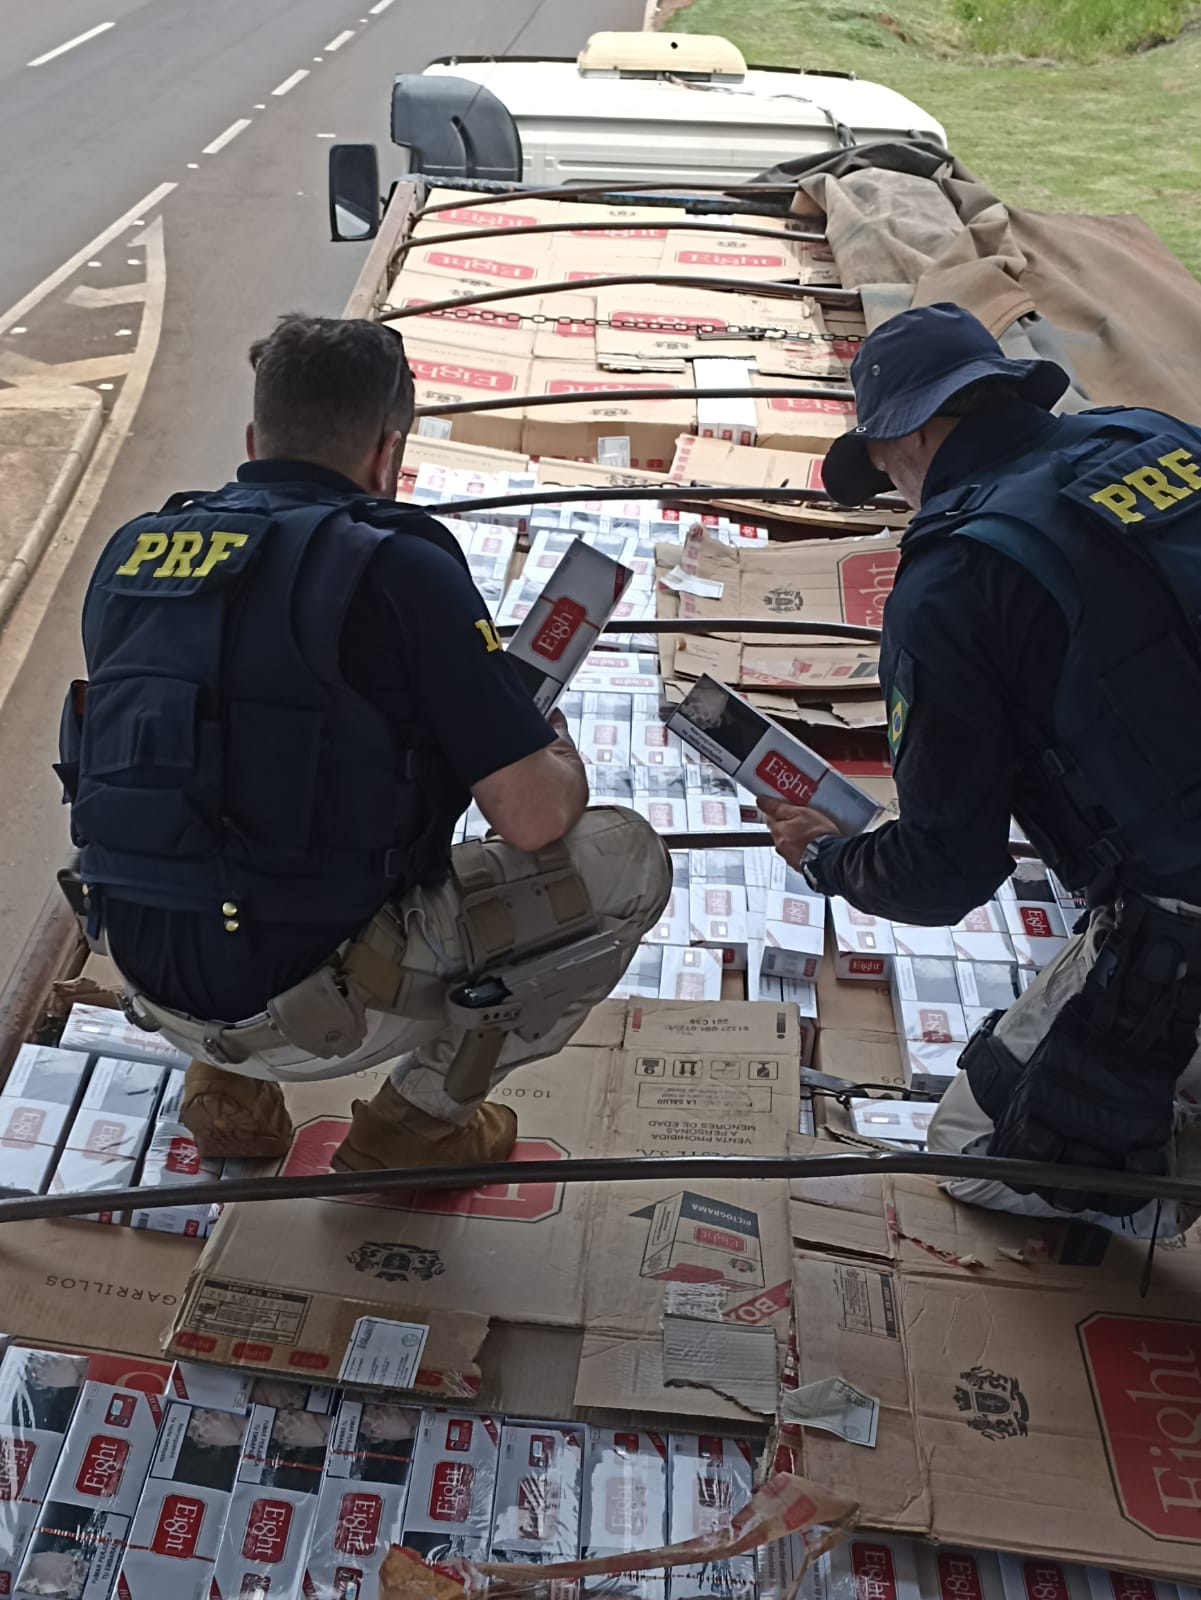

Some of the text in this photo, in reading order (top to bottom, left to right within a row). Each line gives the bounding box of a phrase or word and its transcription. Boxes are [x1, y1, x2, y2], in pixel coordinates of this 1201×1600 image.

[1089, 448, 1201, 524] PRF
[116, 531, 249, 577] PRF
[766, 757, 816, 799] Eight
[1026, 910, 1046, 934] Eight
[853, 960, 881, 973] Eight
[924, 1013, 946, 1040] Eight
[648, 1120, 757, 1131] MENORES DE EDAD
[651, 1133, 752, 1145] VENTA PROHIBIDA
[666, 1128, 728, 1137] PERSONAS
[691, 1203, 753, 1226] PICTOGRAMA
[45, 1275, 177, 1307] GARRILLOS
[260, 1419, 269, 1437] FUMAR
[83, 1440, 120, 1489] Eight
[437, 1466, 468, 1516] Eight
[164, 1502, 199, 1551] Eight
[252, 1505, 286, 1557] Eight
[343, 1499, 378, 1550] Eight
[90, 1563, 102, 1584] FUMAR
[101, 1571, 109, 1580] TU
